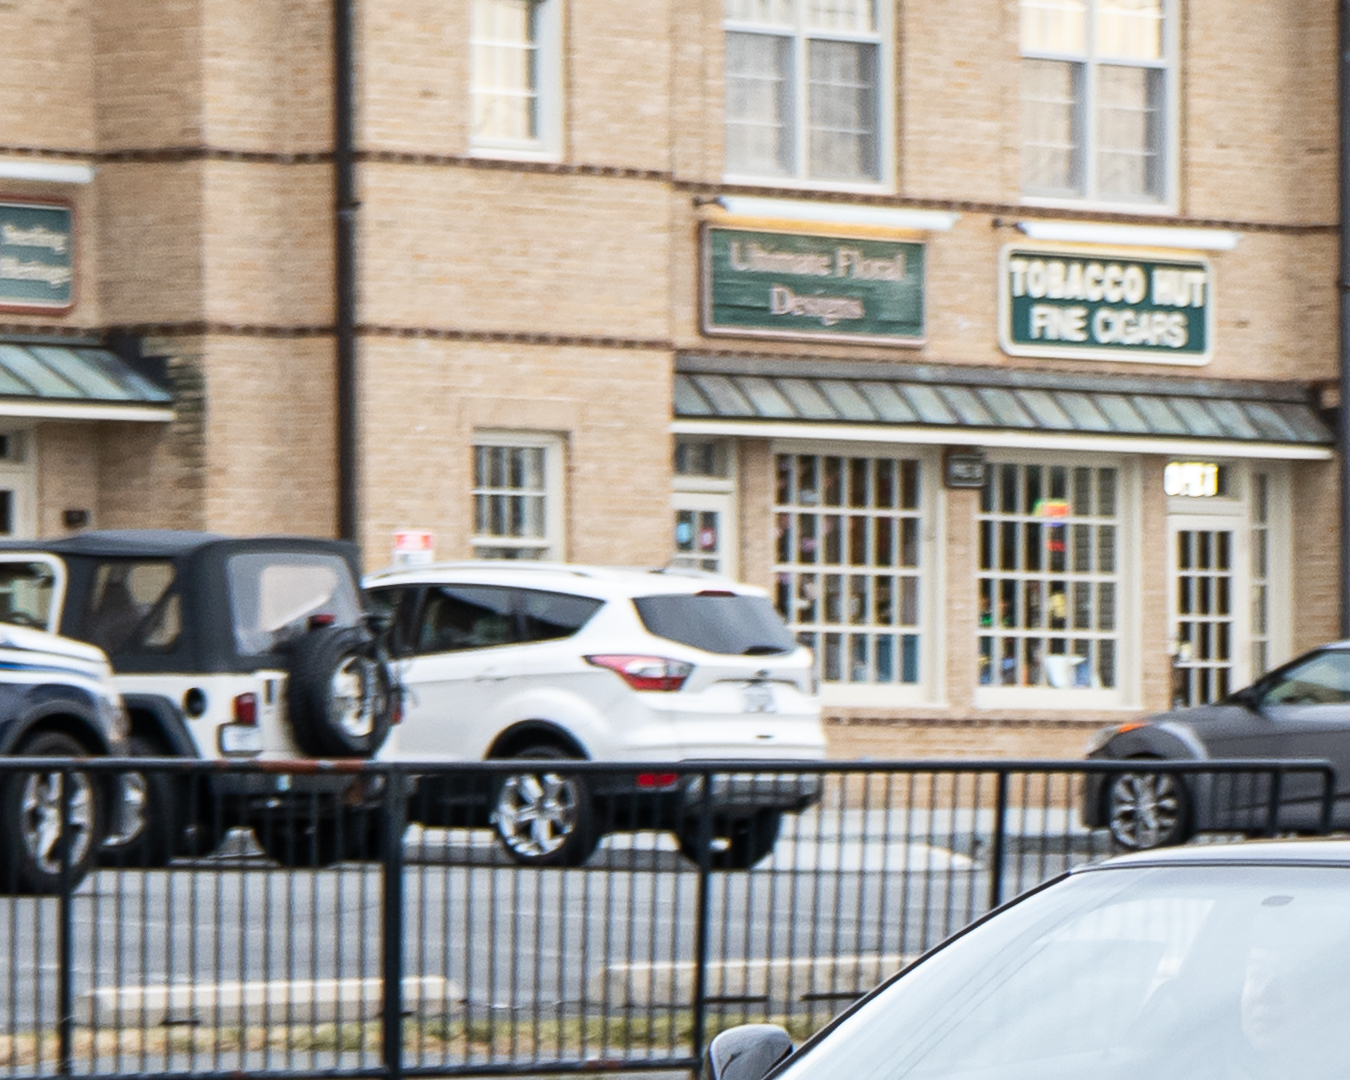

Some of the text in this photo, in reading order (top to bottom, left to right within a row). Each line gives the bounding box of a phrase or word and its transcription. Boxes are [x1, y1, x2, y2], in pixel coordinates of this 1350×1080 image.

[1010, 258, 1147, 304] TOBACCO
[1030, 304, 1188, 349] FINE CIGARS
